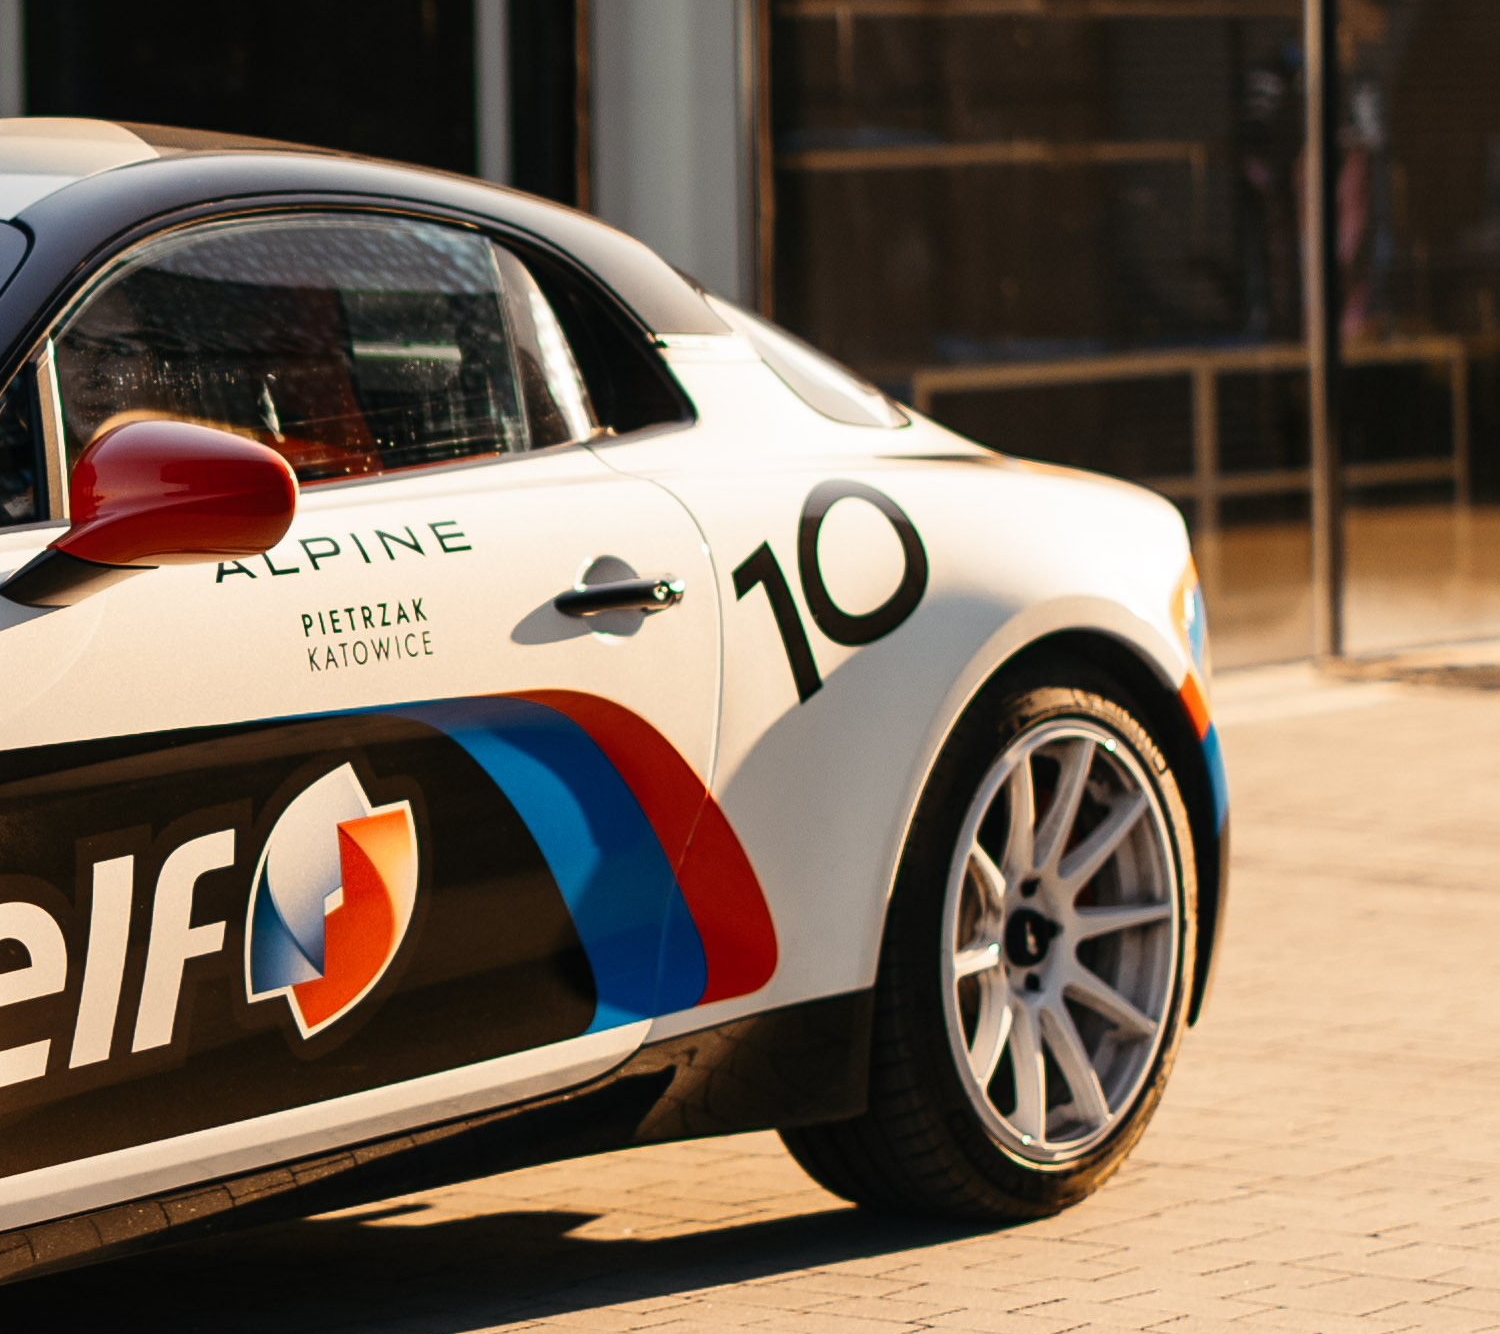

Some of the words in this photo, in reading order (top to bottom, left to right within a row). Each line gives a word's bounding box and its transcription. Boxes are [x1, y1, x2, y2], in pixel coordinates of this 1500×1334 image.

[731, 478, 930, 705] 10
[301, 597, 428, 638] PIETRZAK
[307, 630, 434, 673] KATOWICE
